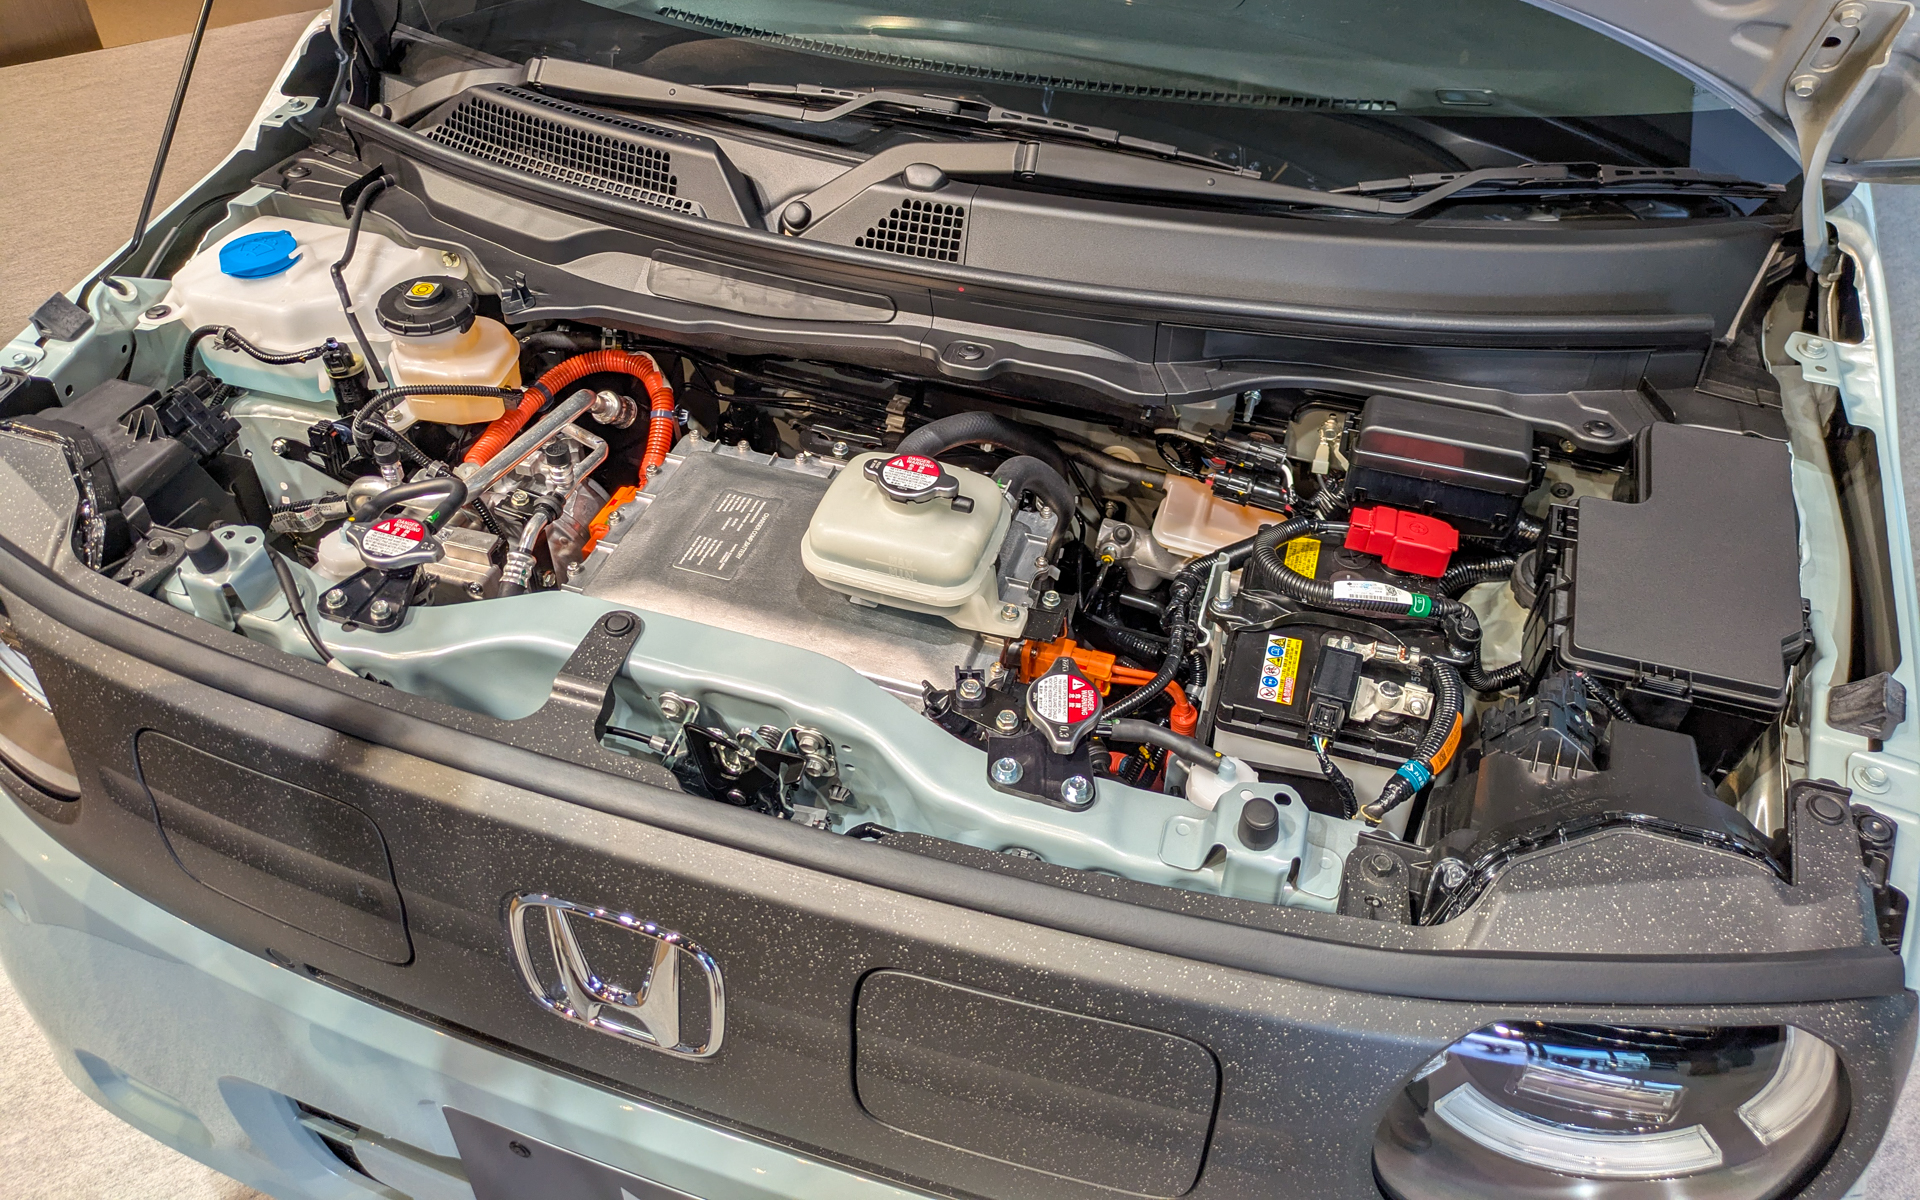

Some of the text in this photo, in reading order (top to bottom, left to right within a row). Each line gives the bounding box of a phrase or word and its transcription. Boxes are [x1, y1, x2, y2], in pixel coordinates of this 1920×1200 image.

[396, 519, 420, 528] DANGER
[888, 567, 914, 581] MIN
[1087, 690, 1095, 711] DANGER
[1059, 726, 1070, 738] 0.3
